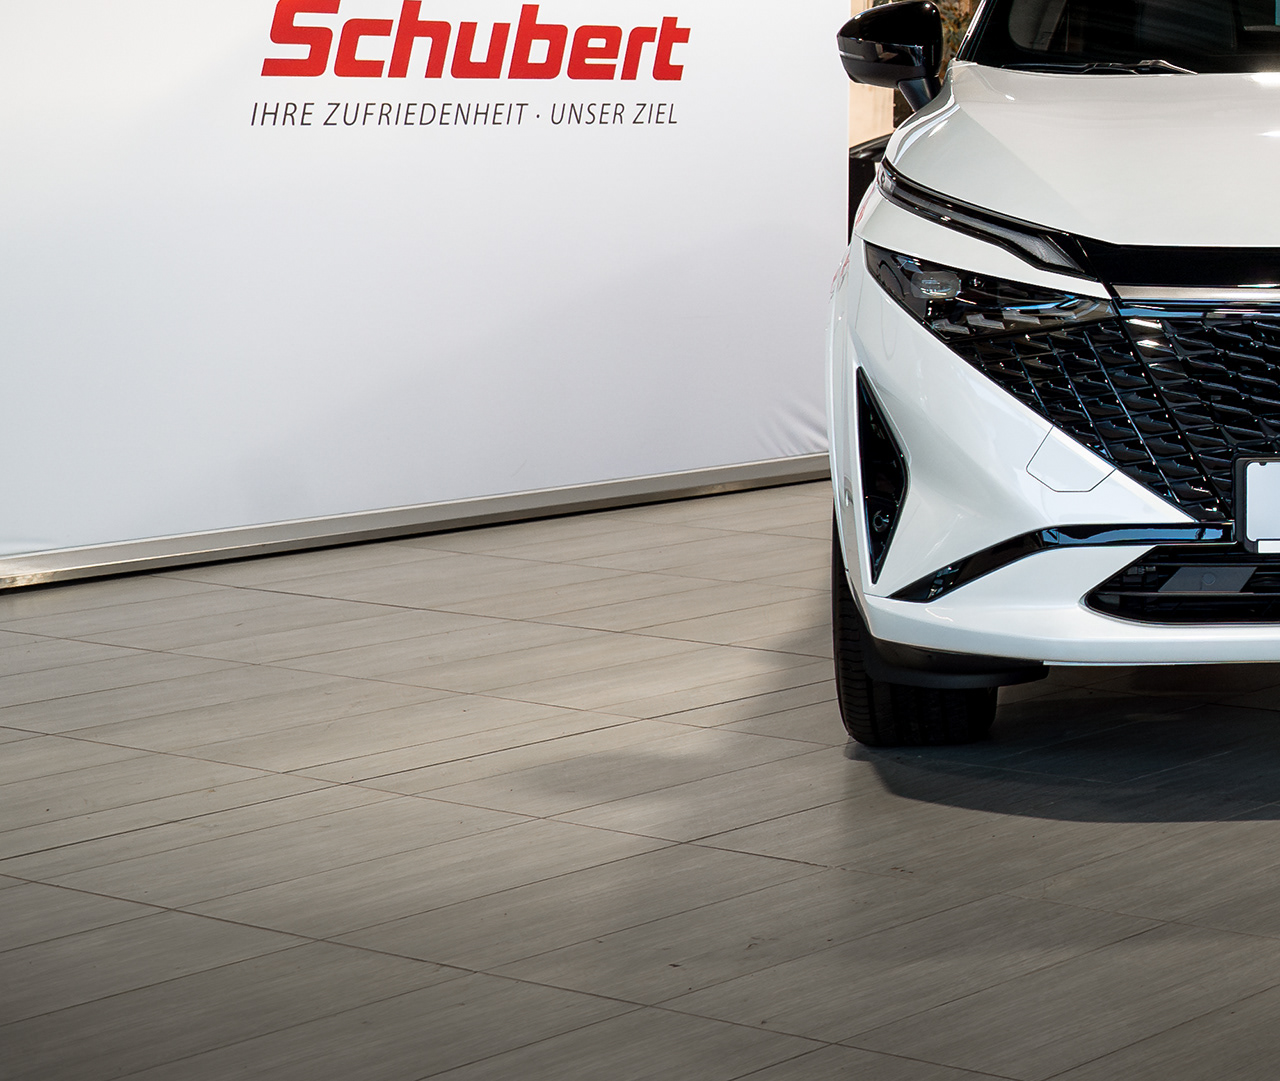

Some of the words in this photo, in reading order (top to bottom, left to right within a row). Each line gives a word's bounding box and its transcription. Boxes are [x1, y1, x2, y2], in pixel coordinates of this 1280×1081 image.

[251, 102, 314, 127] IHRE
[324, 102, 529, 127] ZUFRIEDENHEIT
[550, 102, 626, 126] UNSER
[632, 102, 679, 125] ZIEL
